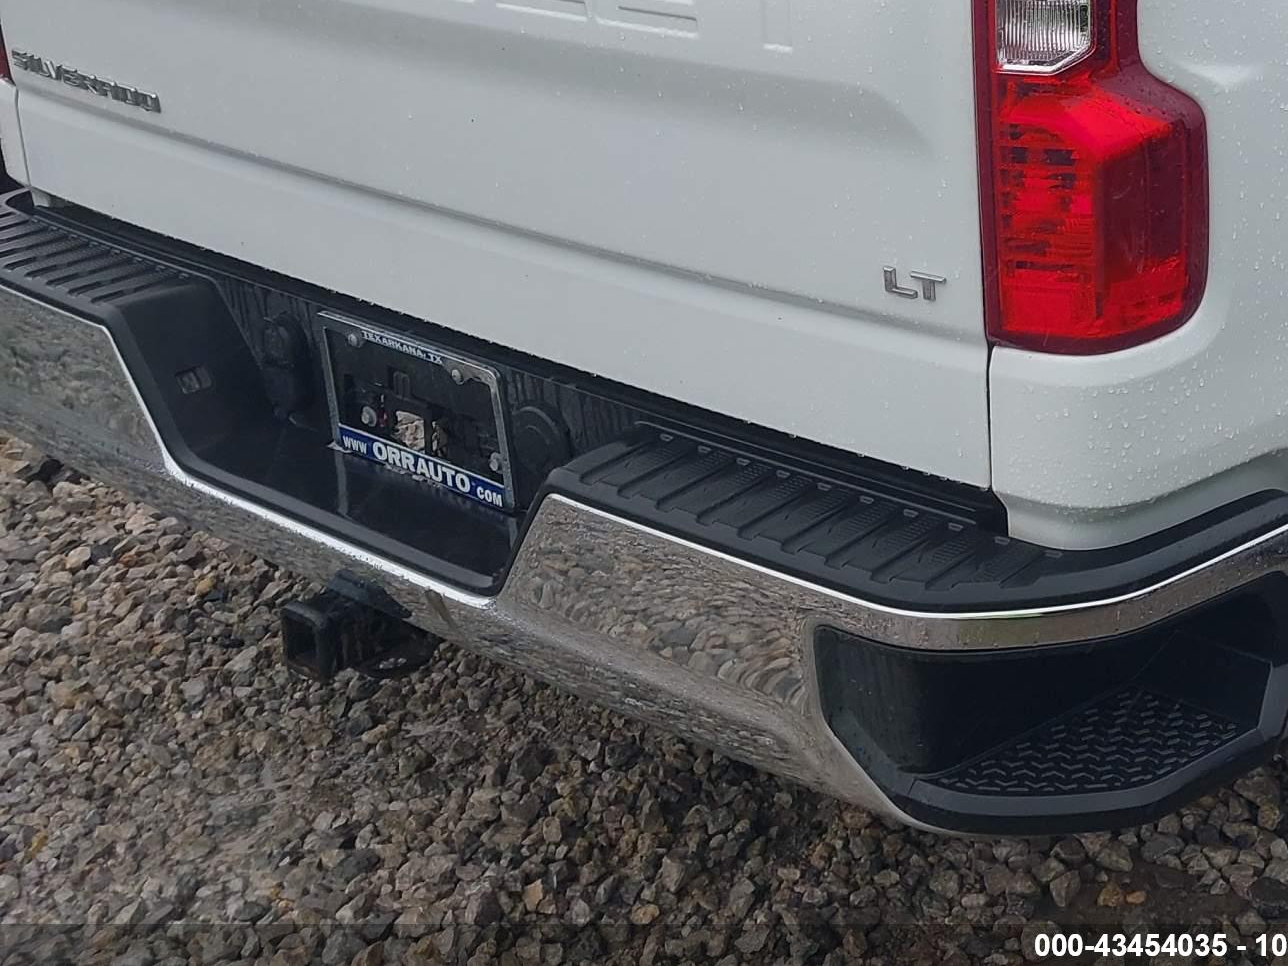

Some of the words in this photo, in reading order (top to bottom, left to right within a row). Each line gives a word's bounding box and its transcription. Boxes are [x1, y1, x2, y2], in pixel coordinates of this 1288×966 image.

[11, 49, 162, 114] SILVERADO
[883, 265, 947, 301] LT
[372, 441, 471, 493] ORRAUTO
